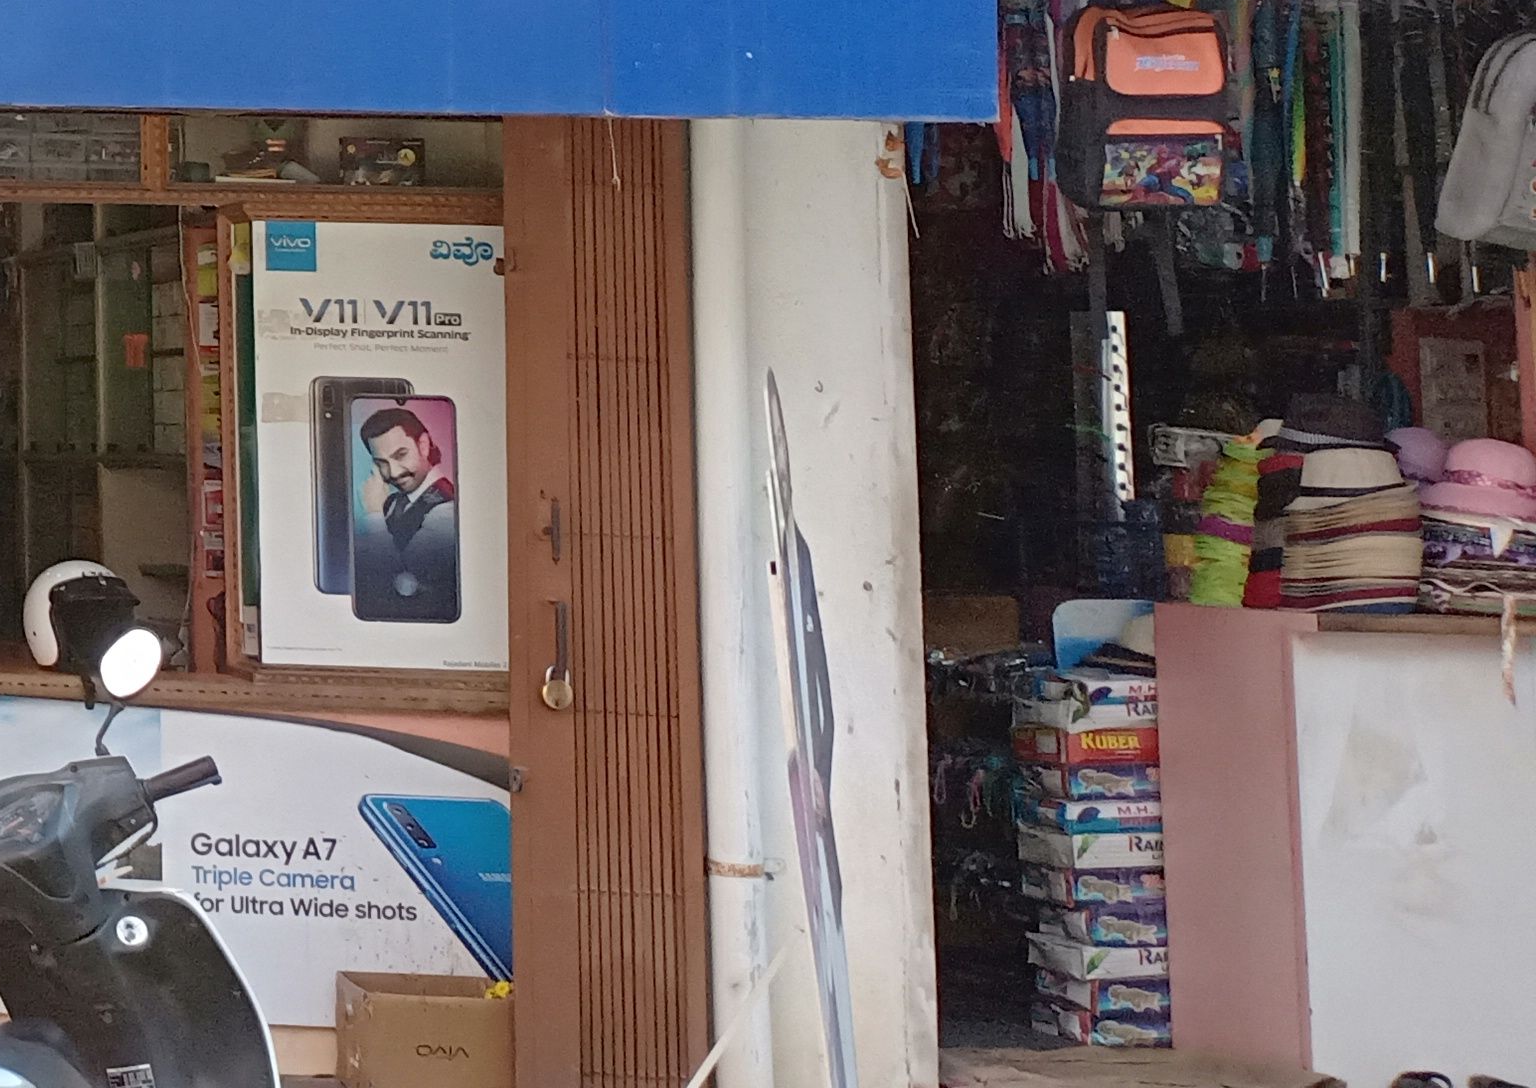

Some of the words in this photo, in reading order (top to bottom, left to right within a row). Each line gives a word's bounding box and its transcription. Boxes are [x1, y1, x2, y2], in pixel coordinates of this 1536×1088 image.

[270, 235, 312, 248] vivo
[299, 298, 358, 324] V11
[373, 299, 432, 326] V11
[435, 313, 462, 326] Pro
[290, 326, 348, 338] In-Display
[351, 327, 415, 340] Fingerprint
[1080, 731, 1141, 750] KUBER
[191, 832, 297, 865] Galaxy
[302, 837, 337, 861] A7
[191, 864, 253, 891] Triple
[259, 869, 356, 891] Camera
[231, 896, 284, 916] Ultra
[290, 898, 349, 918] Wide
[355, 900, 418, 921] shots
